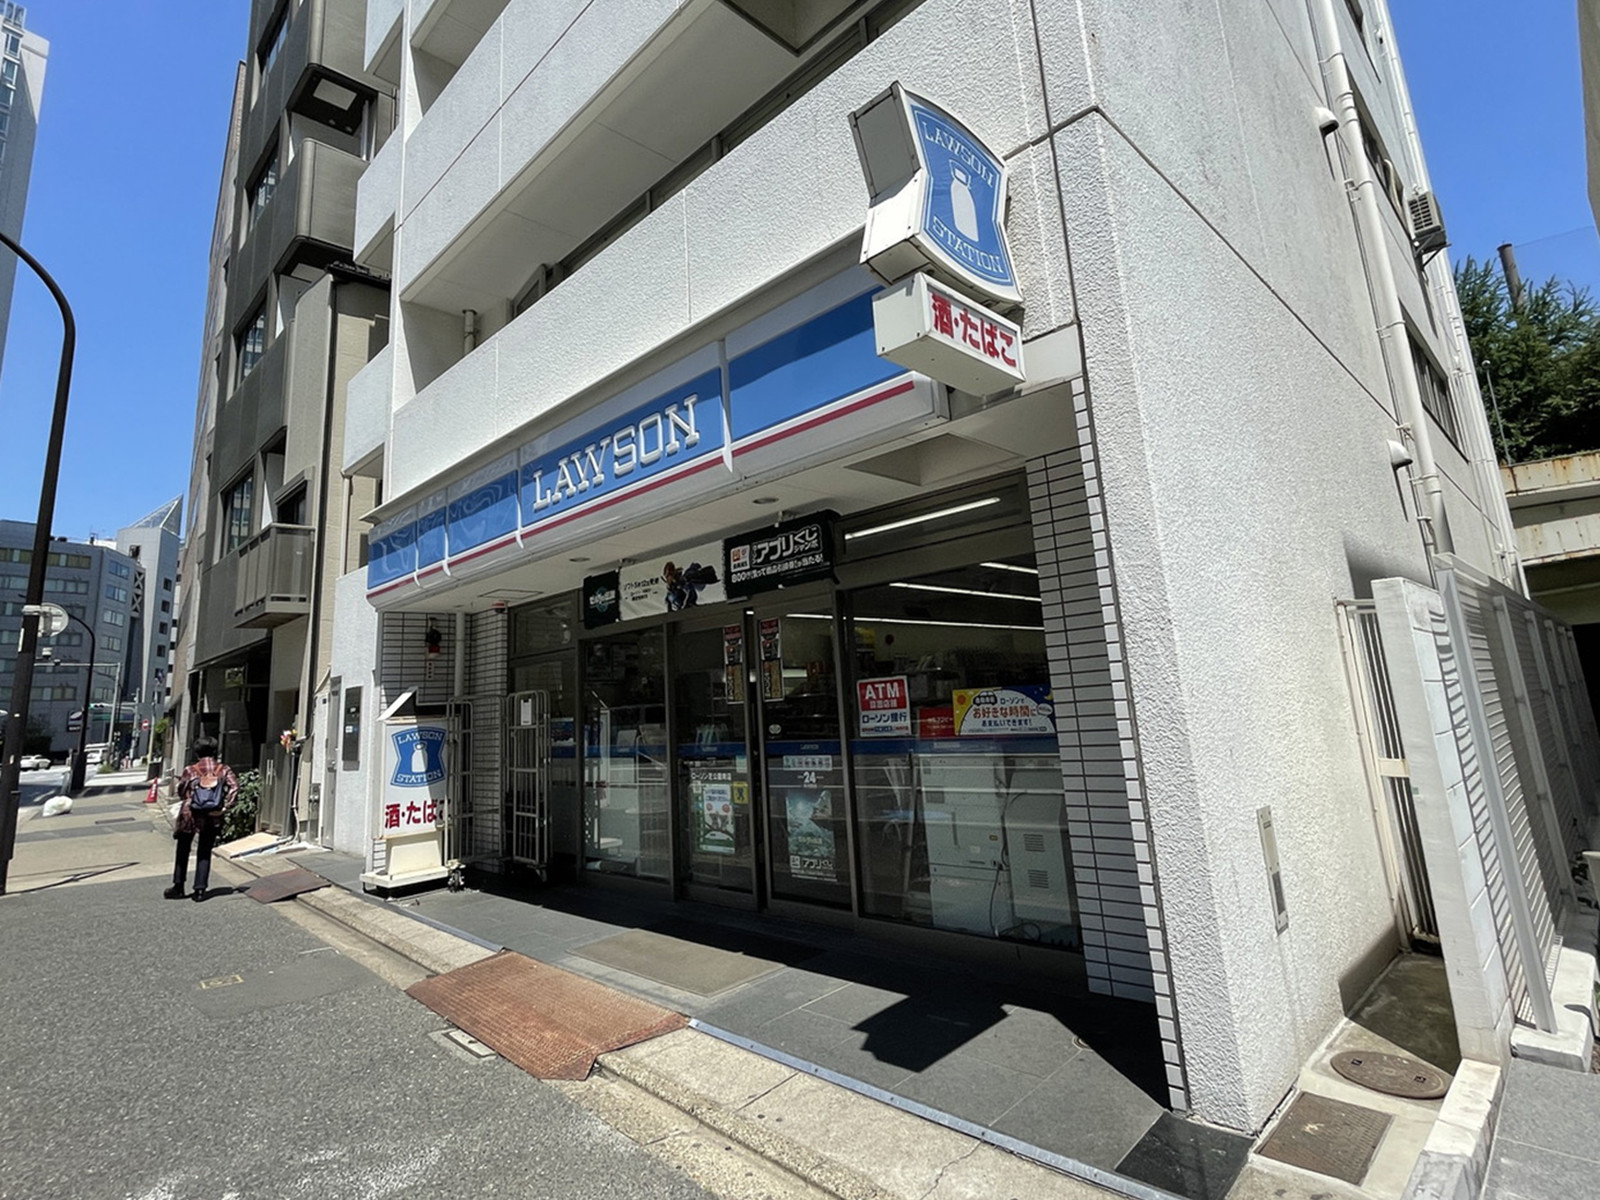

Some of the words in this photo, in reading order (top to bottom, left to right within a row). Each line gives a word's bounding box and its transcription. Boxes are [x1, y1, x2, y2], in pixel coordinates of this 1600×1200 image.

[921, 120, 994, 188] LAWSON
[932, 215, 1004, 274] STATION
[932, 292, 1017, 367] 酒・たばこ
[533, 394, 700, 511] LAWSON
[864, 681, 900, 700] ATM
[862, 711, 907, 724] ローソン銀行
[972, 705, 1037, 719] お好きな時間に
[397, 731, 443, 743] LAWSON
[396, 769, 442, 784] STATION
[802, 771, 817, 784] 24
